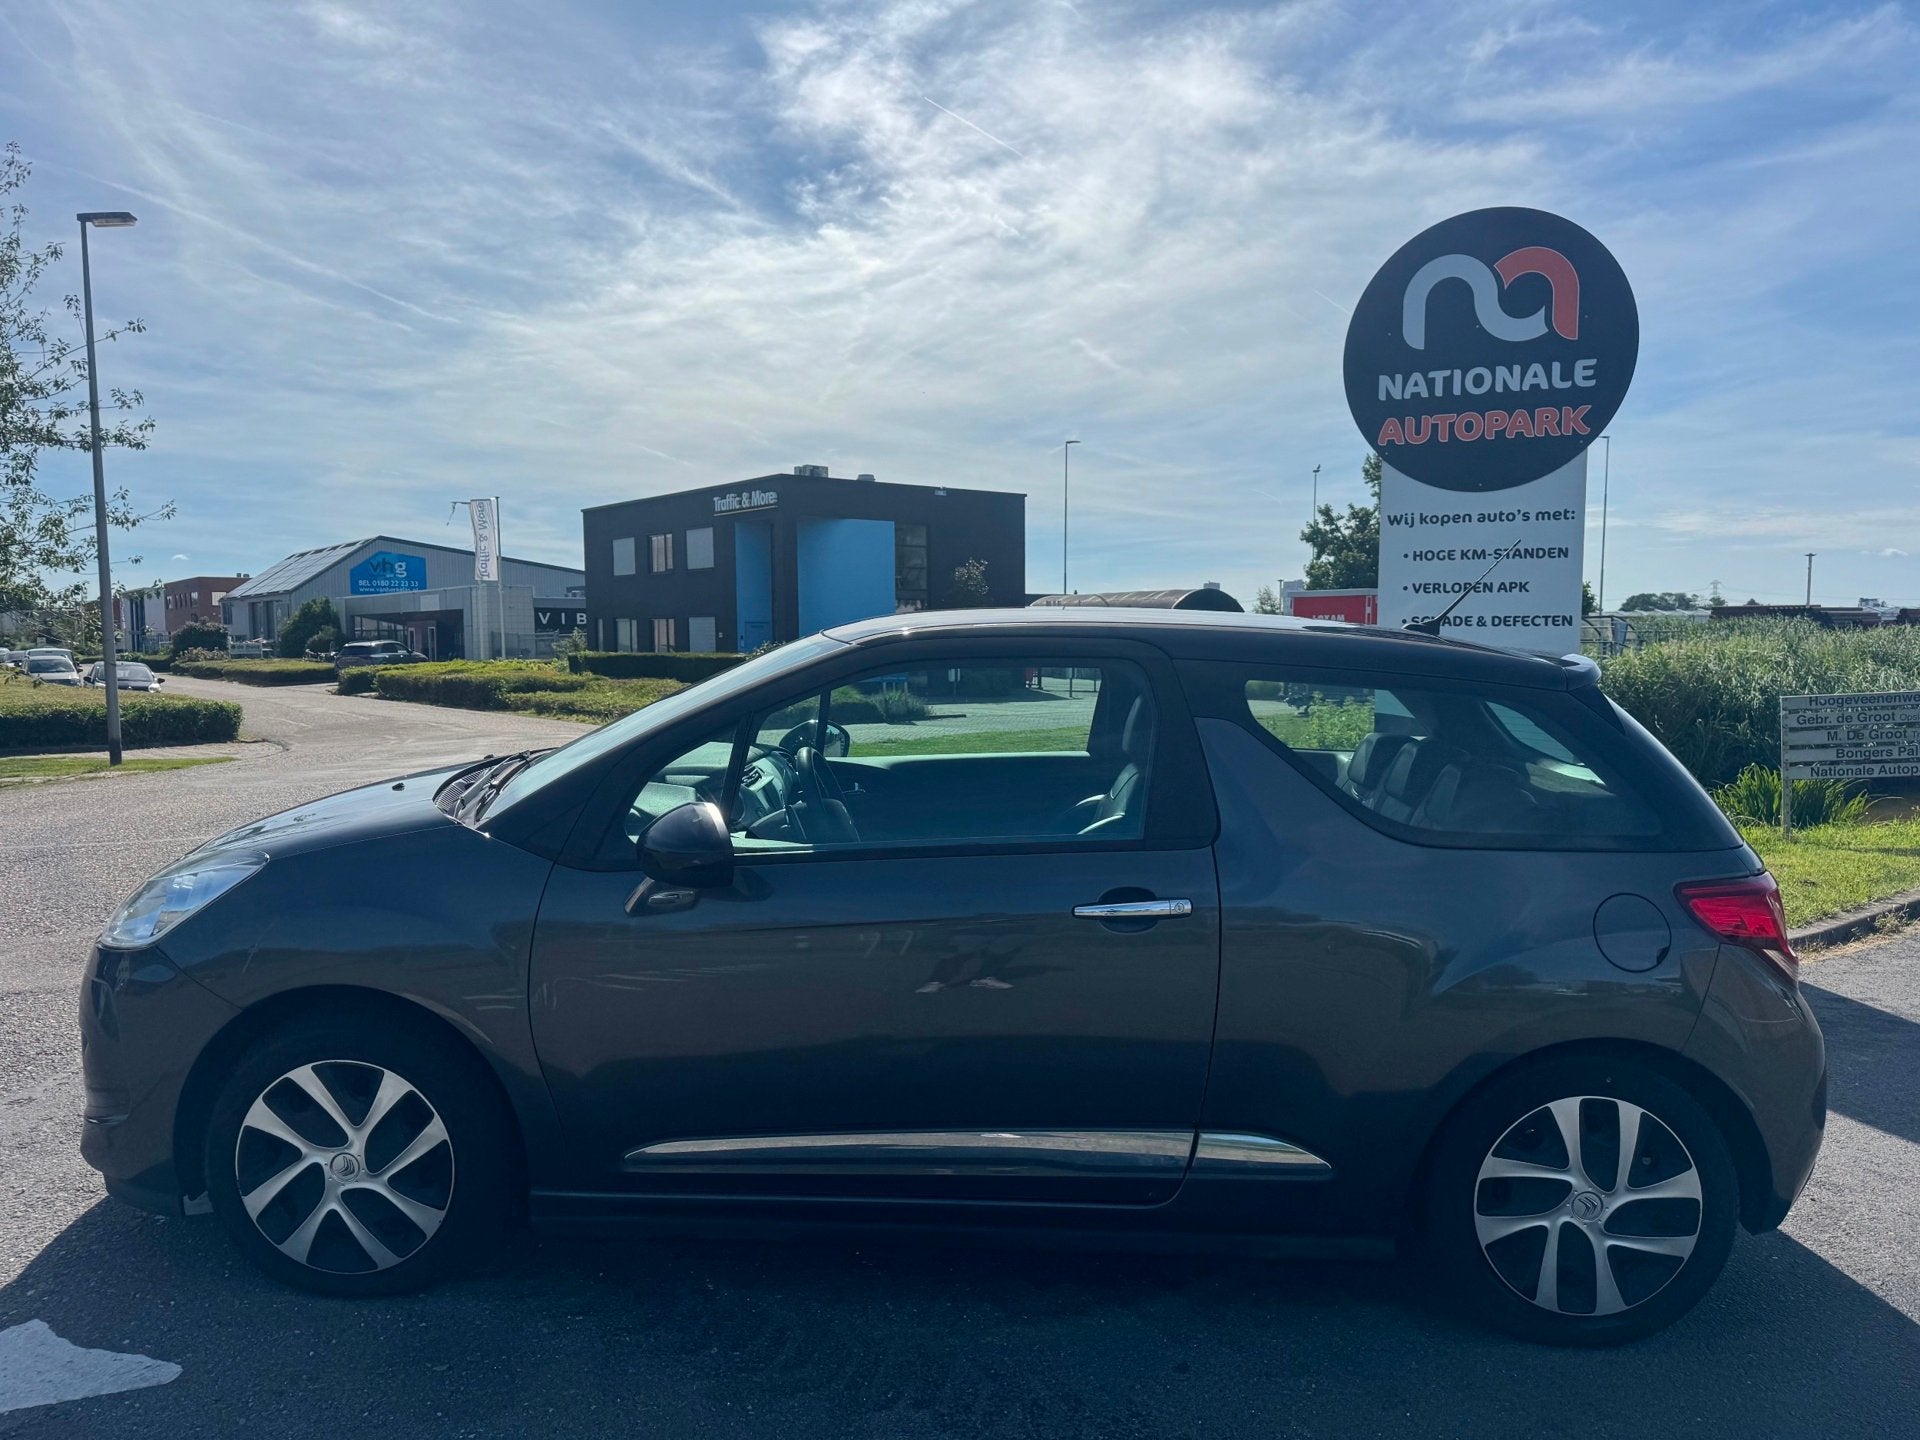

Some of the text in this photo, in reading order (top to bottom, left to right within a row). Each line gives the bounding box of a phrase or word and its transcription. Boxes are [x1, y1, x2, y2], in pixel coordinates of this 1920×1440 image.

[1378, 359, 1597, 401] NATIONALE
[1378, 405, 1592, 446] AUTOPARK
[713, 490, 778, 512] Traffic & More
[1387, 508, 1576, 528] Wij kopen auto's met:
[1412, 547, 1569, 562] HOGE KM-STANDEN
[369, 557, 407, 578] vhg
[1412, 581, 1530, 594] VERLOPEN APK
[1411, 614, 1573, 627] SCADE & DEFECTEN
[1797, 714, 1832, 726] Gebr.
[1836, 712, 1853, 723] de
[1857, 712, 1895, 722] Groot
[1827, 731, 1842, 741] M.
[1847, 730, 1864, 740] De
[1869, 729, 1907, 740] Groot
[1836, 746, 1919, 760] Bongers Pal
[1811, 764, 1920, 777] Nationale Autop
